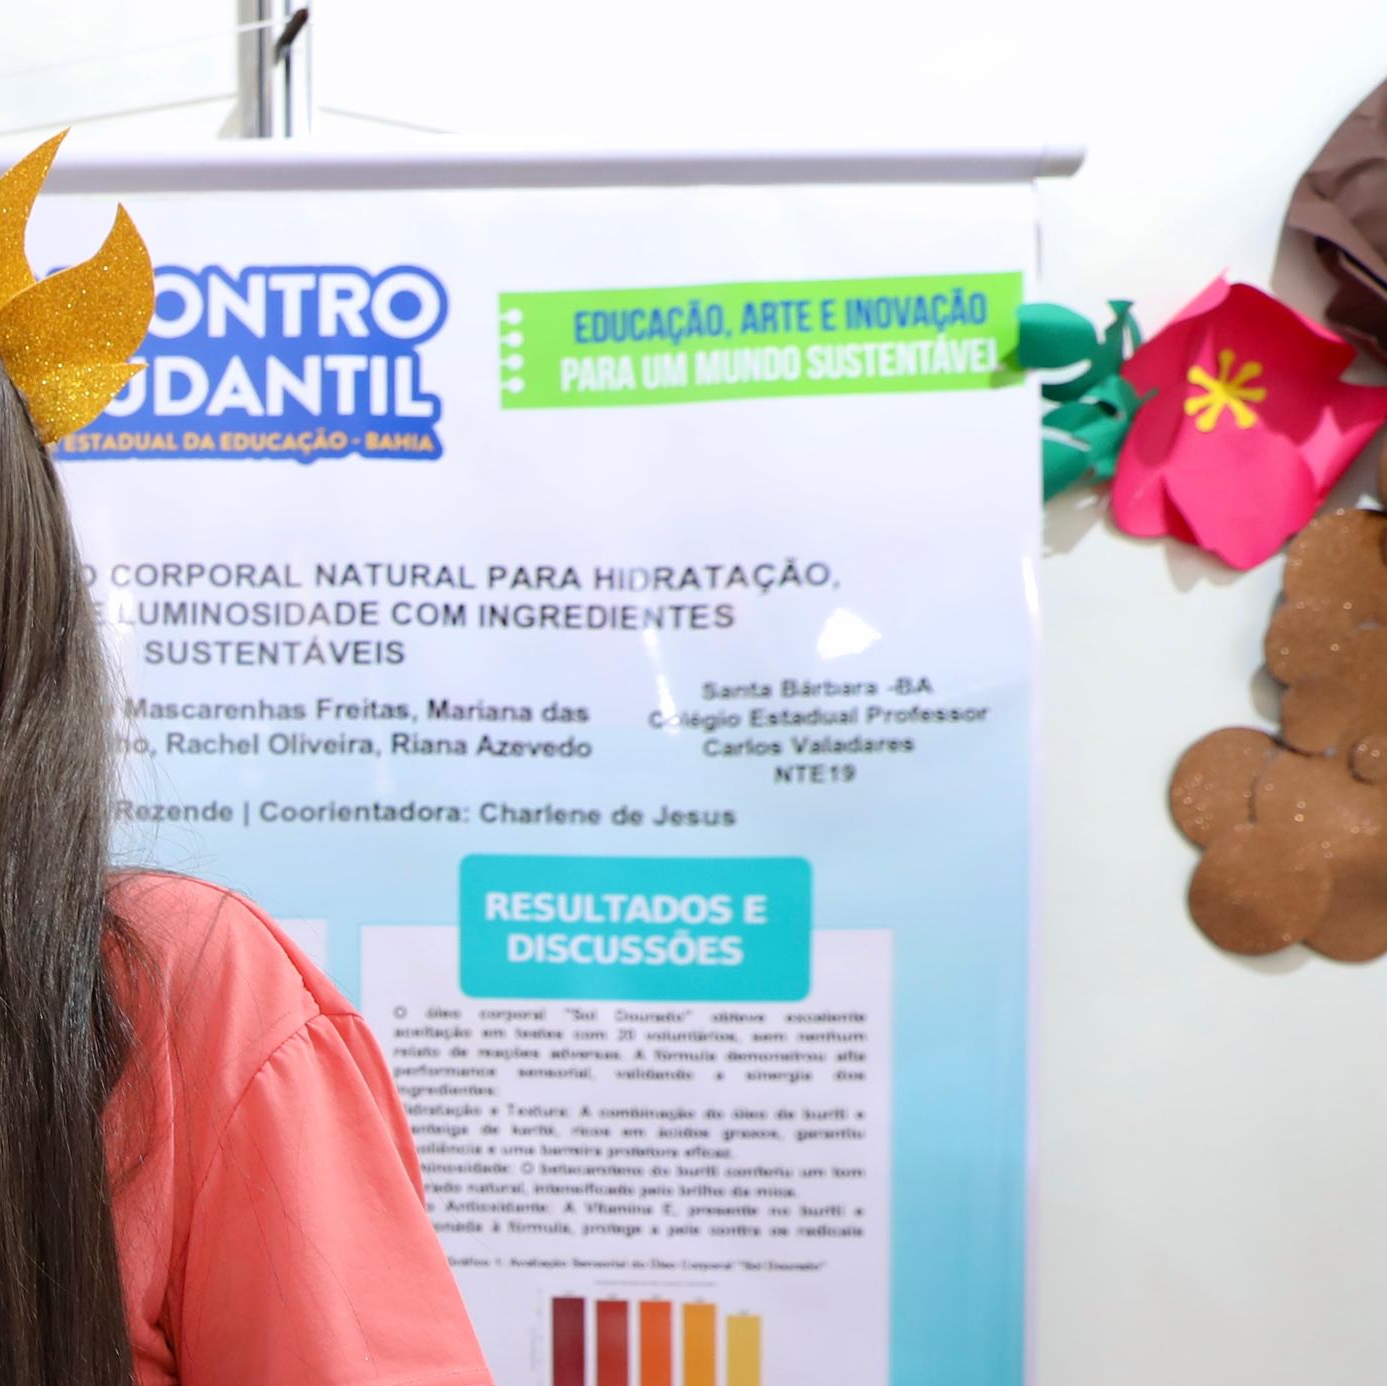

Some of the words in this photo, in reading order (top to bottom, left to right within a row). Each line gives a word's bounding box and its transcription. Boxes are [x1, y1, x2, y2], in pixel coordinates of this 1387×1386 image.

[149, 273, 440, 339] ONTRO
[574, 300, 731, 346] EDUCAÇÃO,
[741, 300, 811, 335] ARTE
[821, 299, 835, 331] E
[845, 288, 986, 332] INOVAÇÃO
[560, 355, 634, 392] PARA
[642, 351, 688, 388] UM
[694, 346, 799, 386] MUNDO
[102, 355, 434, 417] UDANTIL
[64, 432, 178, 451] ESTADUAL
[183, 432, 216, 451] DA
[224, 427, 347, 455] EDUCAÇÃO
[365, 432, 434, 452] BAHIA
[110, 563, 302, 590] CORPORAL
[314, 562, 477, 590] NATURAL
[487, 564, 583, 591] PARA
[593, 556, 840, 594] HIDRATAÇÃO,
[118, 601, 381, 628] LUMINOSIDADE
[390, 601, 467, 628] COM
[478, 602, 736, 631] INGREDIENTES
[143, 635, 406, 667] SUSTENTÁVEIS
[701, 681, 773, 701] Santa
[780, 678, 879, 699] Bárbara
[125, 698, 307, 721] Mascarenhas
[315, 697, 419, 724] Freitas,
[426, 697, 534, 723] Mariana
[540, 700, 591, 724] das
[748, 706, 859, 727] Estadual
[865, 704, 990, 724] Professor
[165, 731, 260, 756] Rachel
[267, 732, 382, 758] Oliveira,
[390, 732, 469, 756] Riana
[475, 733, 593, 759] Azevedo
[702, 737, 784, 758] Carlos
[790, 734, 916, 755] Valadares
[774, 763, 857, 784] NTE19
[117, 801, 234, 823] Rezende
[259, 800, 470, 823] Coorientadora:
[479, 801, 603, 826] Charlene
[610, 804, 645, 827] de
[652, 805, 737, 827] Jesus
[485, 892, 733, 926] RESULTADOS
[744, 895, 768, 926] E
[509, 930, 744, 967] DISCUSSÕES
